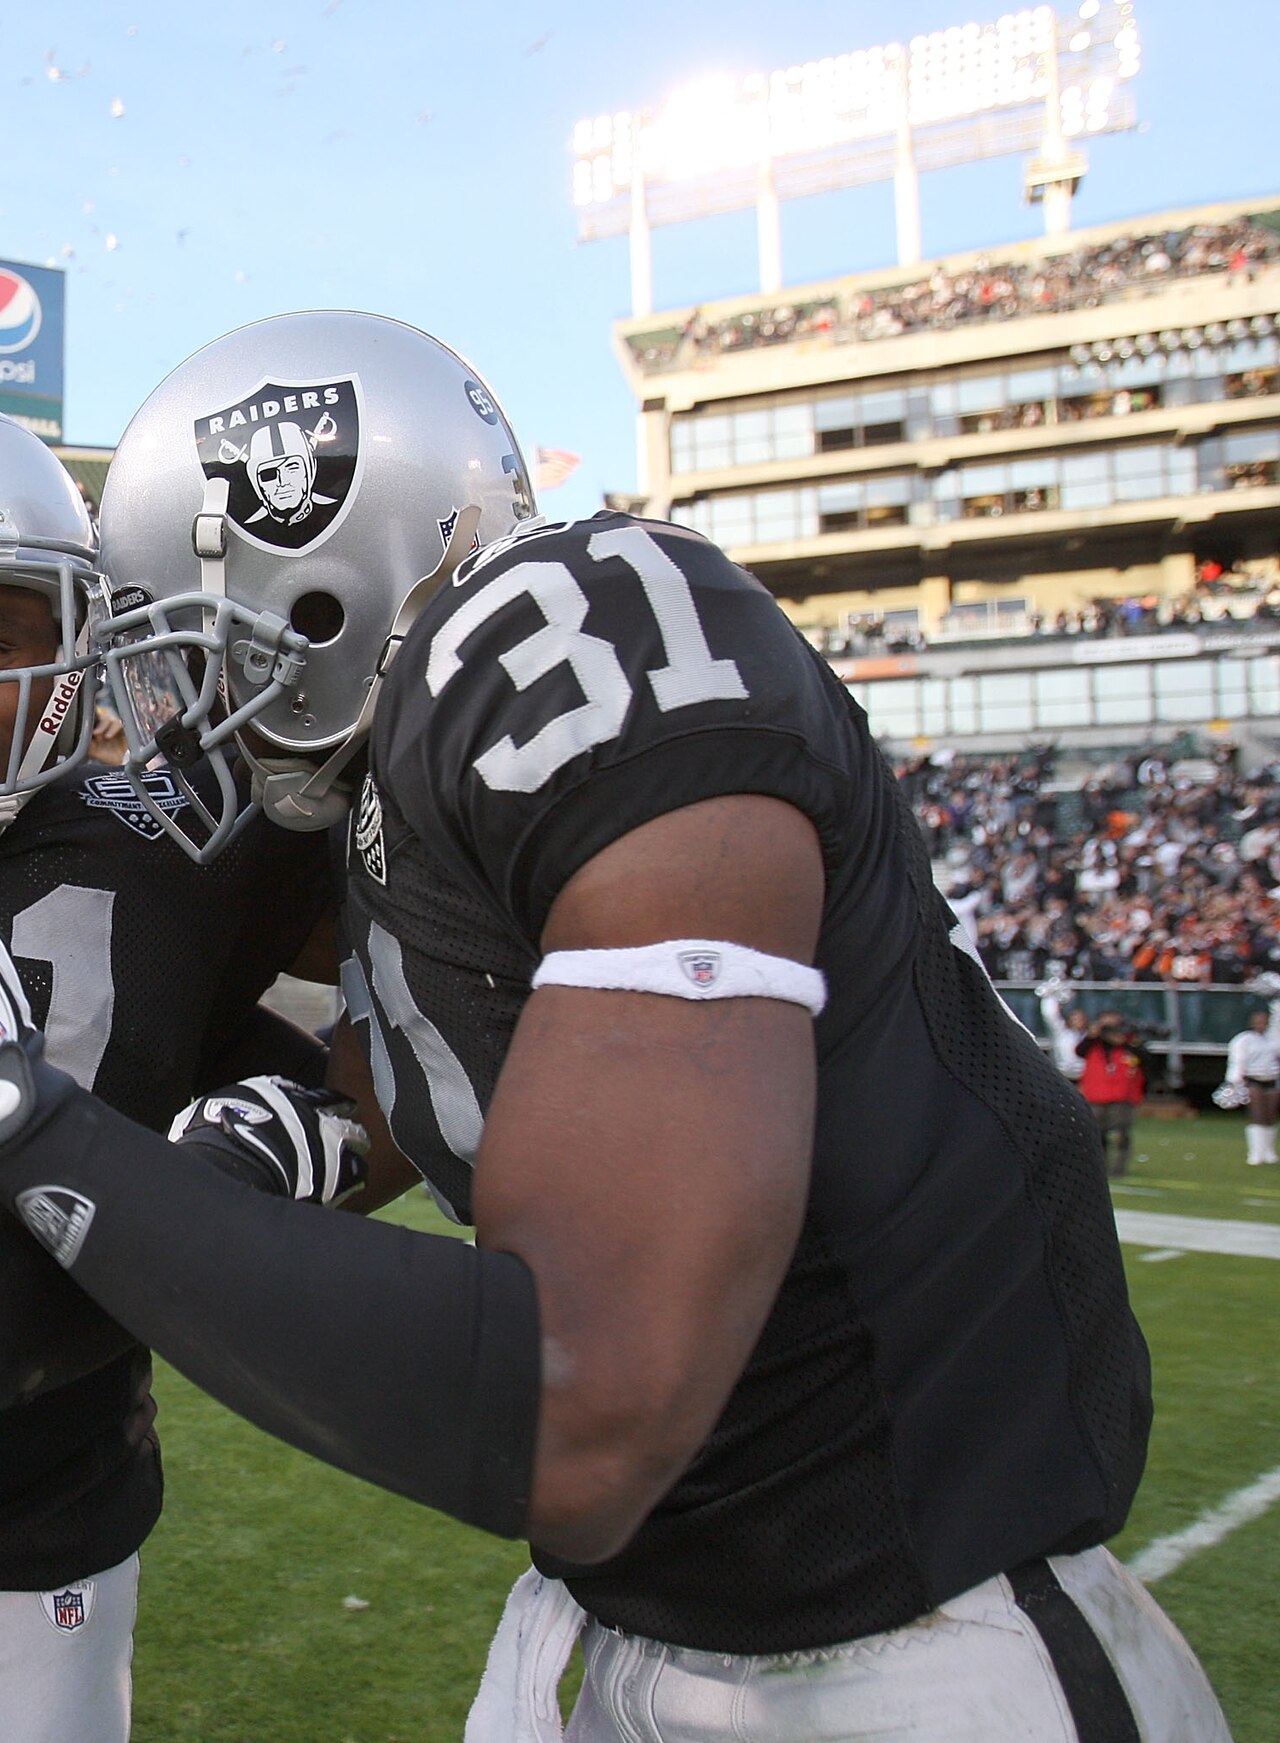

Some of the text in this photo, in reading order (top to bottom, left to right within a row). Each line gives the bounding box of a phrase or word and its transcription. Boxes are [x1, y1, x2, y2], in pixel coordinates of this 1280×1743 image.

[209, 387, 340, 434] RAIDERS
[469, 388, 494, 416] 95
[112, 590, 145, 611] RAIDERS
[425, 526, 750, 794] 31
[58, 1607, 83, 1626] NFL
